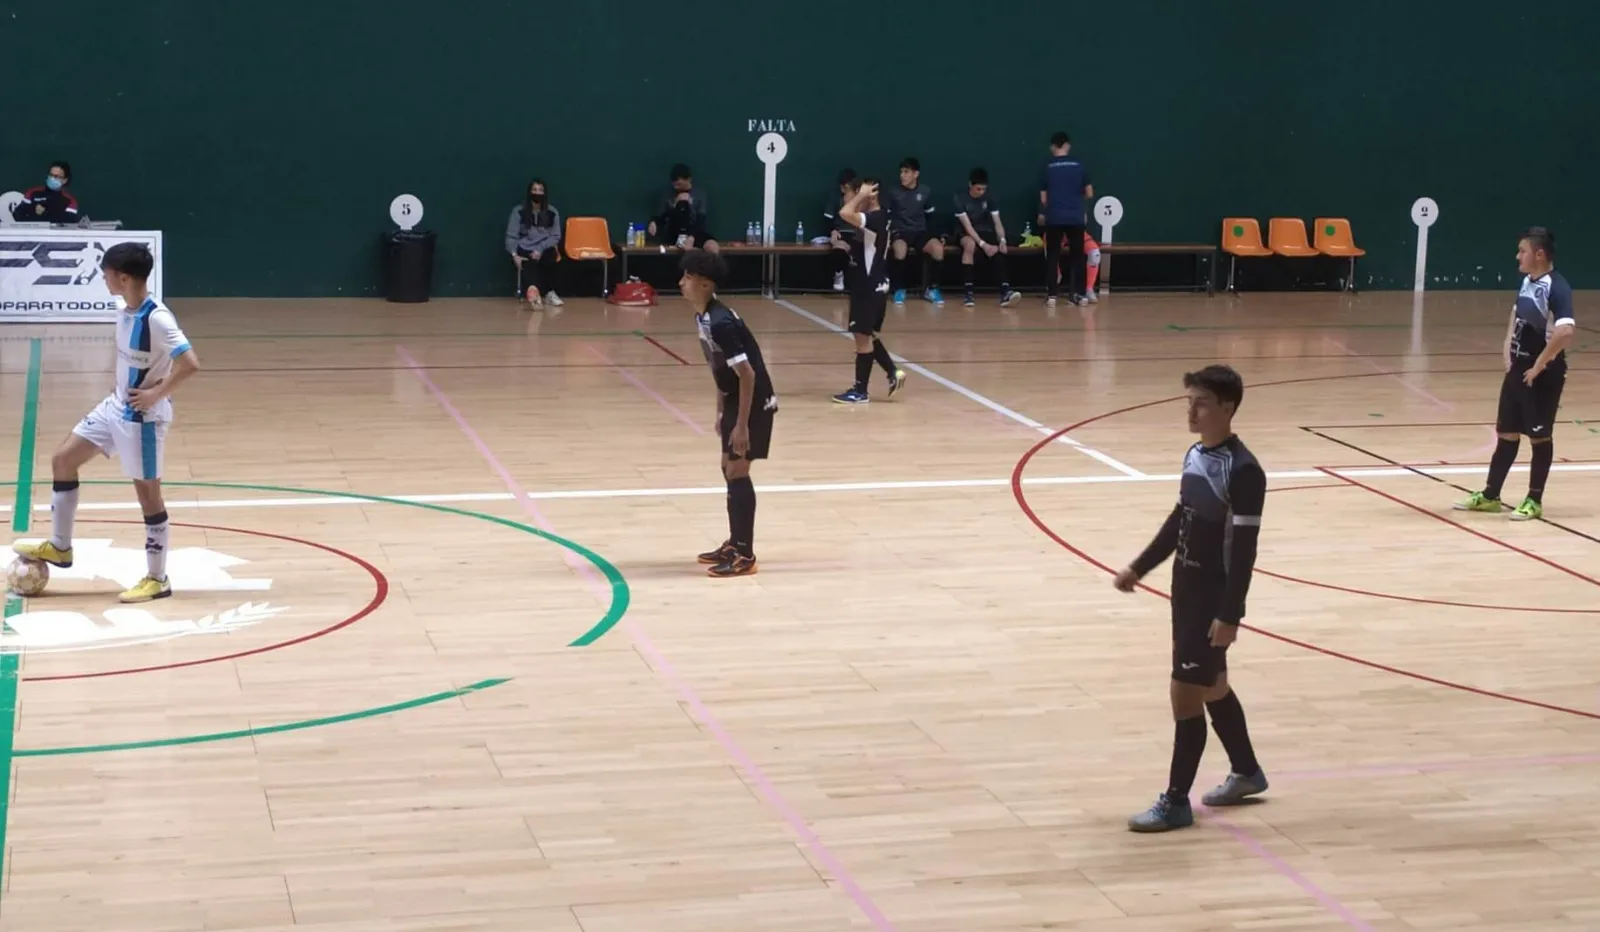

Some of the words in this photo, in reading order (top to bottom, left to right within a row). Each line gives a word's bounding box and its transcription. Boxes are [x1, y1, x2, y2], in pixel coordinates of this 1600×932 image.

[748, 119, 796, 132] FALTA
[766, 141, 775, 153] 4
[401, 203, 411, 216] 5
[1420, 206, 1428, 217] 2
[0, 301, 117, 310] PARATODOS
